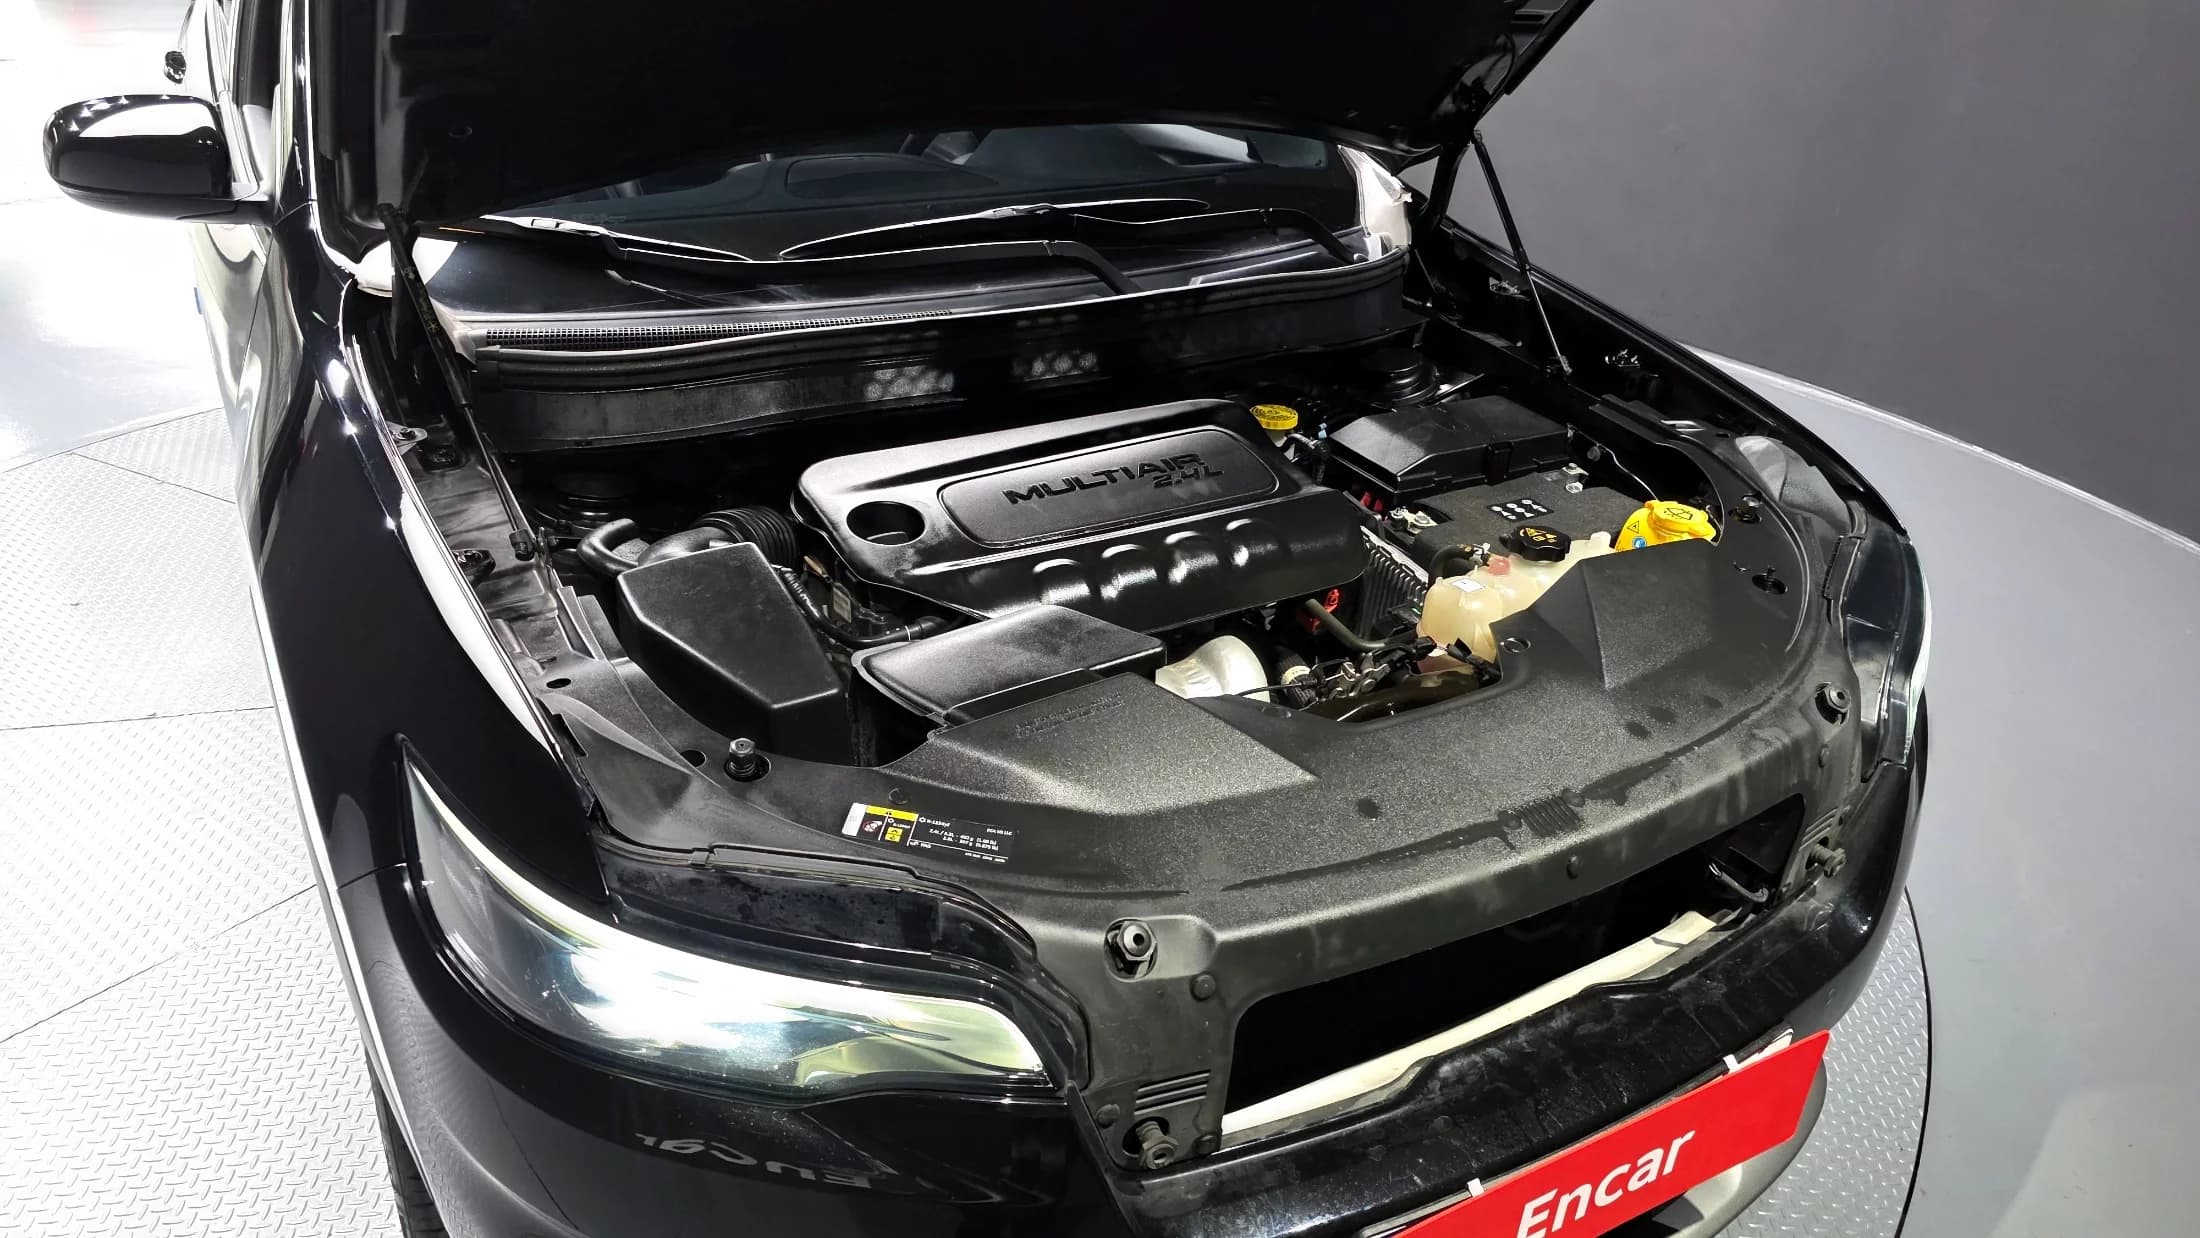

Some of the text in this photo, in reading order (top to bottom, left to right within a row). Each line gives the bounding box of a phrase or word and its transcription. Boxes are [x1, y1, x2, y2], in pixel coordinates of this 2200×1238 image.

[1002, 453, 1205, 504] MULTIAIR
[1152, 465, 1225, 489] 2.4L
[1516, 1130, 1696, 1238] Encar
